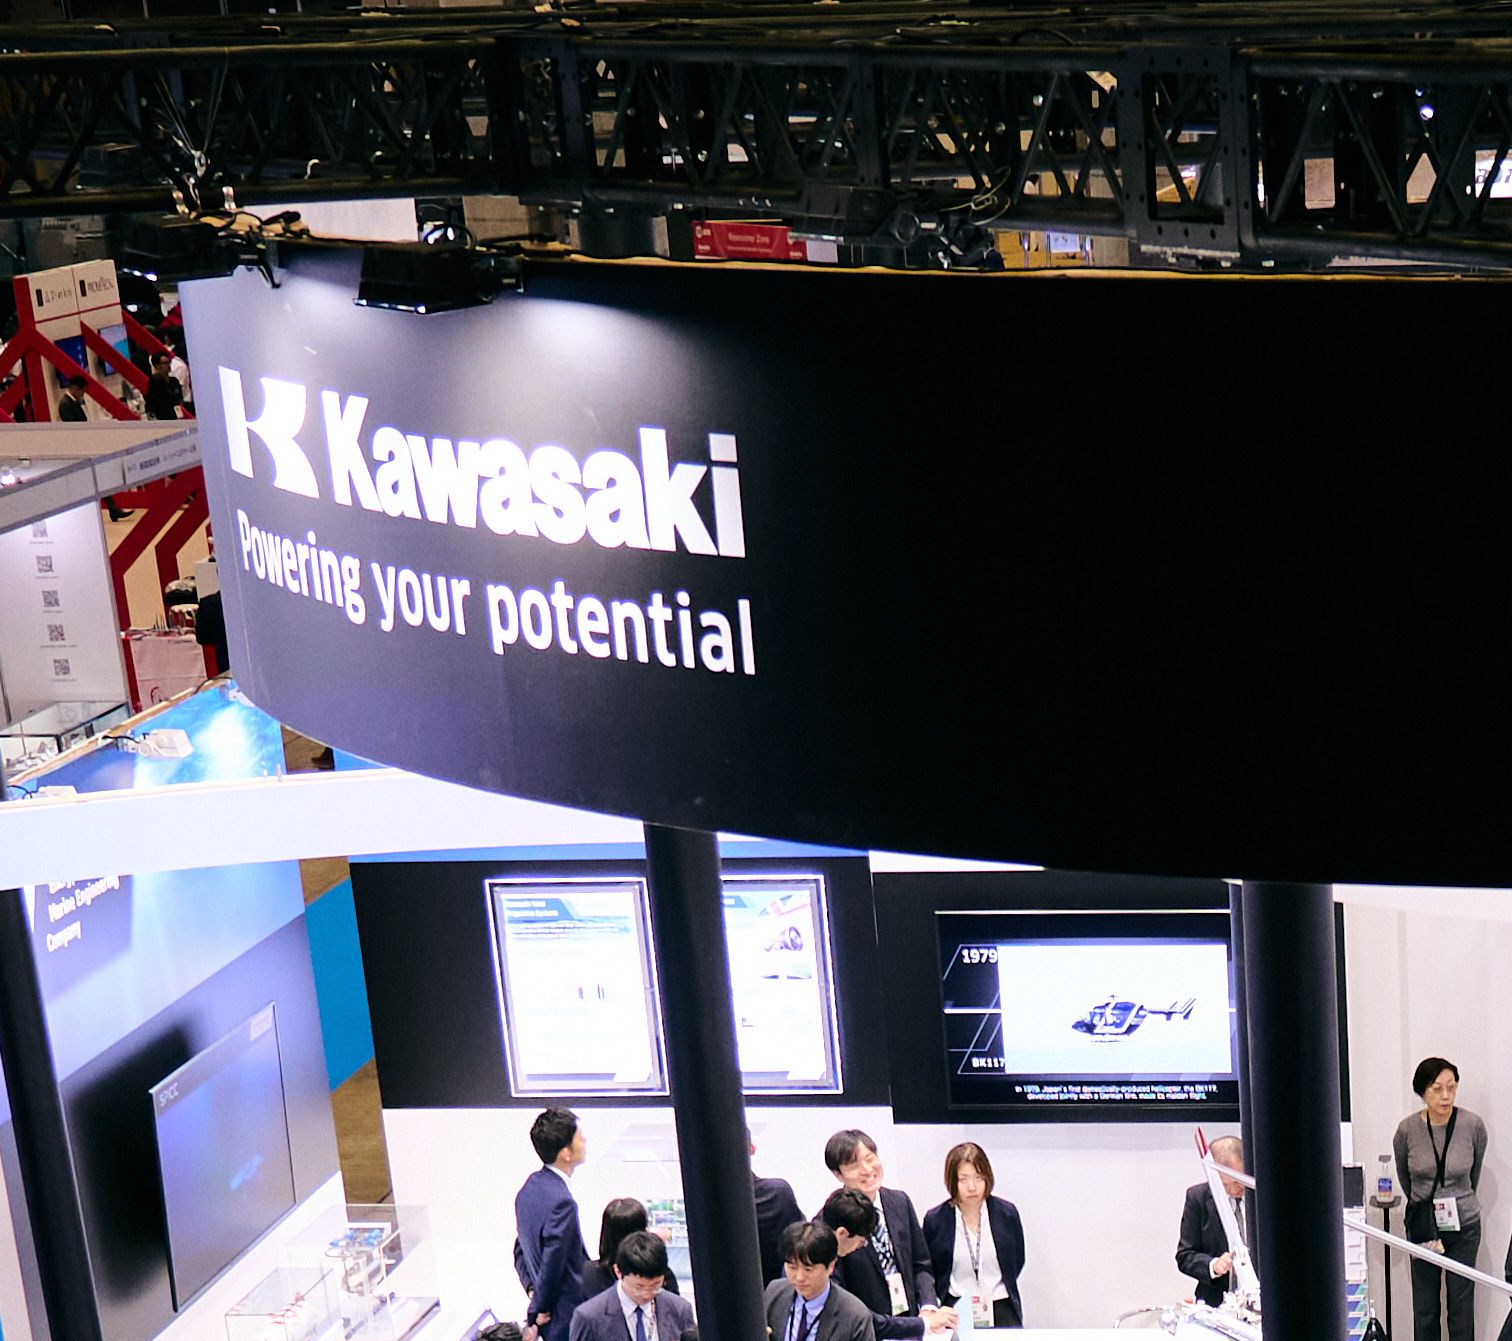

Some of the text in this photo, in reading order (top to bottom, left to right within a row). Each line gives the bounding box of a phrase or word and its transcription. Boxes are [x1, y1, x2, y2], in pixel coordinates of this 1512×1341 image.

[320, 388, 746, 559] Kawasaki
[237, 509, 757, 676] Powering your potential
[961, 948, 998, 964] 1979
[972, 1057, 1005, 1068] BK117
